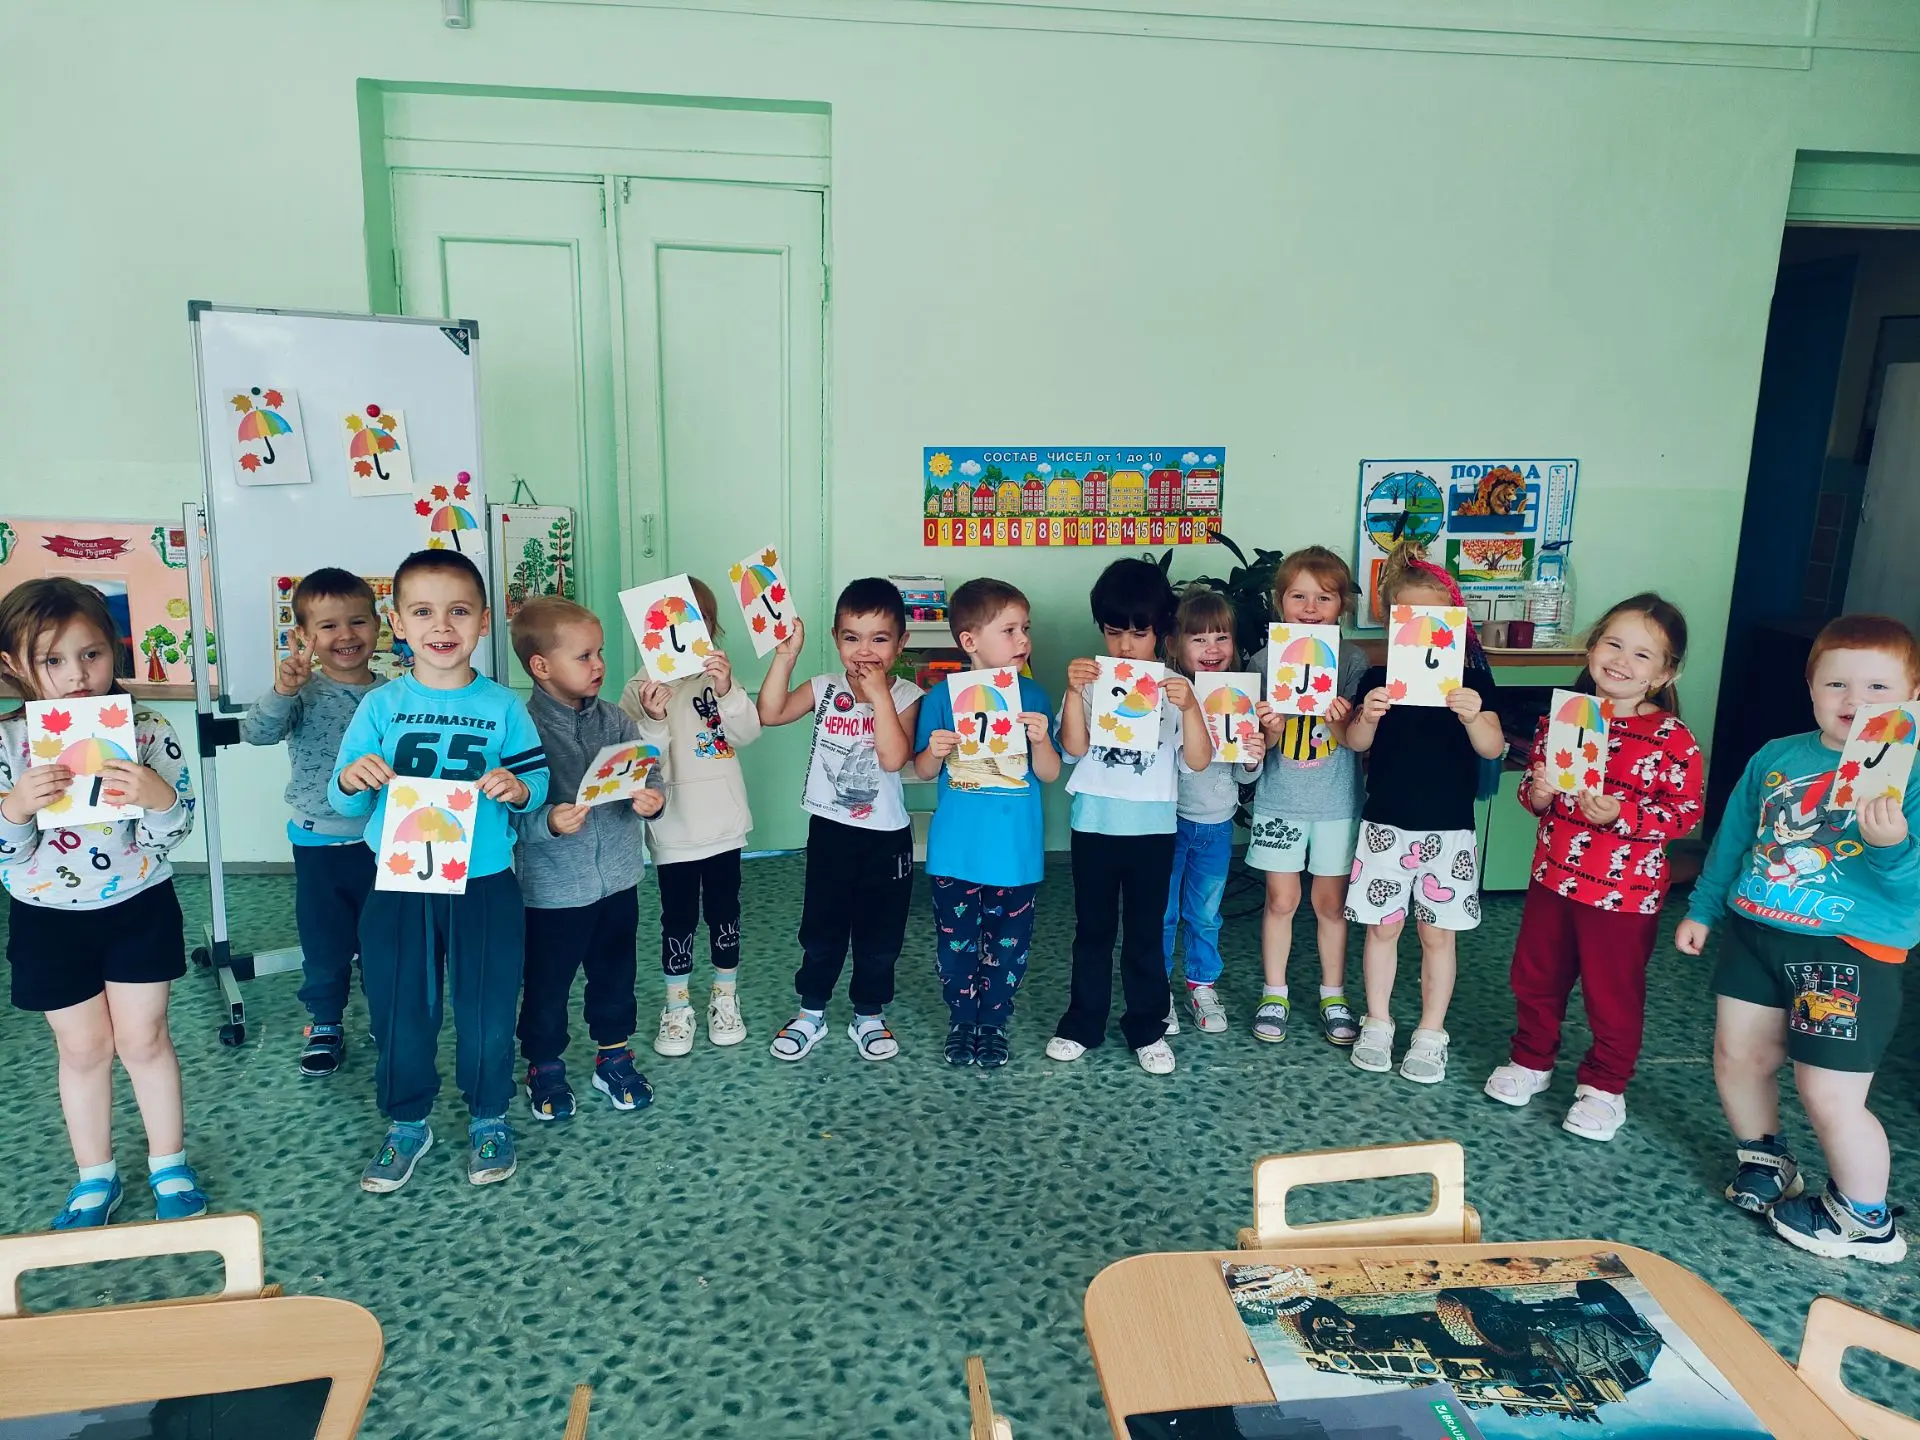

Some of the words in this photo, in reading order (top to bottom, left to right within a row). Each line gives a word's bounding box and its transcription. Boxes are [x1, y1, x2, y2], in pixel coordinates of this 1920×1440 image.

[983, 452, 1038, 462] СОСТАВ
[1047, 452, 1092, 462] ЧИСЕЛ
[1097, 454, 1111, 462] от
[1116, 452, 1121, 462] 1
[1126, 454, 1143, 463] до
[1148, 452, 1162, 462] 10
[1451, 464, 1541, 480] ПОГА
[927, 523, 936, 539] 0
[942, 523, 949, 540] 1
[955, 523, 964, 540] 2
[969, 522, 977, 539] 3
[982, 522, 992, 539] 4
[997, 522, 1006, 539] 5
[1011, 522, 1020, 539] 6
[1025, 522, 1034, 539] 7
[1039, 522, 1047, 539] 8
[1052, 522, 1061, 539] 9
[1065, 523, 1077, 538] 10
[1080, 522, 1091, 538] 11
[1093, 522, 1106, 538] 12
[1107, 522, 1120, 538] 13
[1121, 522, 1135, 538] 14
[1136, 522, 1149, 538] 15
[1150, 522, 1163, 538] 16
[1164, 522, 1177, 538] 17
[1180, 521, 1192, 538] 18
[1193, 521, 1206, 537] 19
[815, 699, 830, 725] ЧЕРНОГО
[825, 683, 837, 700] МОРЯ
[391, 712, 497, 731] PEEDMASTER
[825, 716, 859, 737] ЧЕРНО
[393, 732, 488, 782] 65
[48, 831, 82, 854] 10
[1252, 838, 1292, 850] paradise
[1755, 906, 1818, 925] HEDGEHOG
[1791, 1019, 1852, 1037] ROUTE
